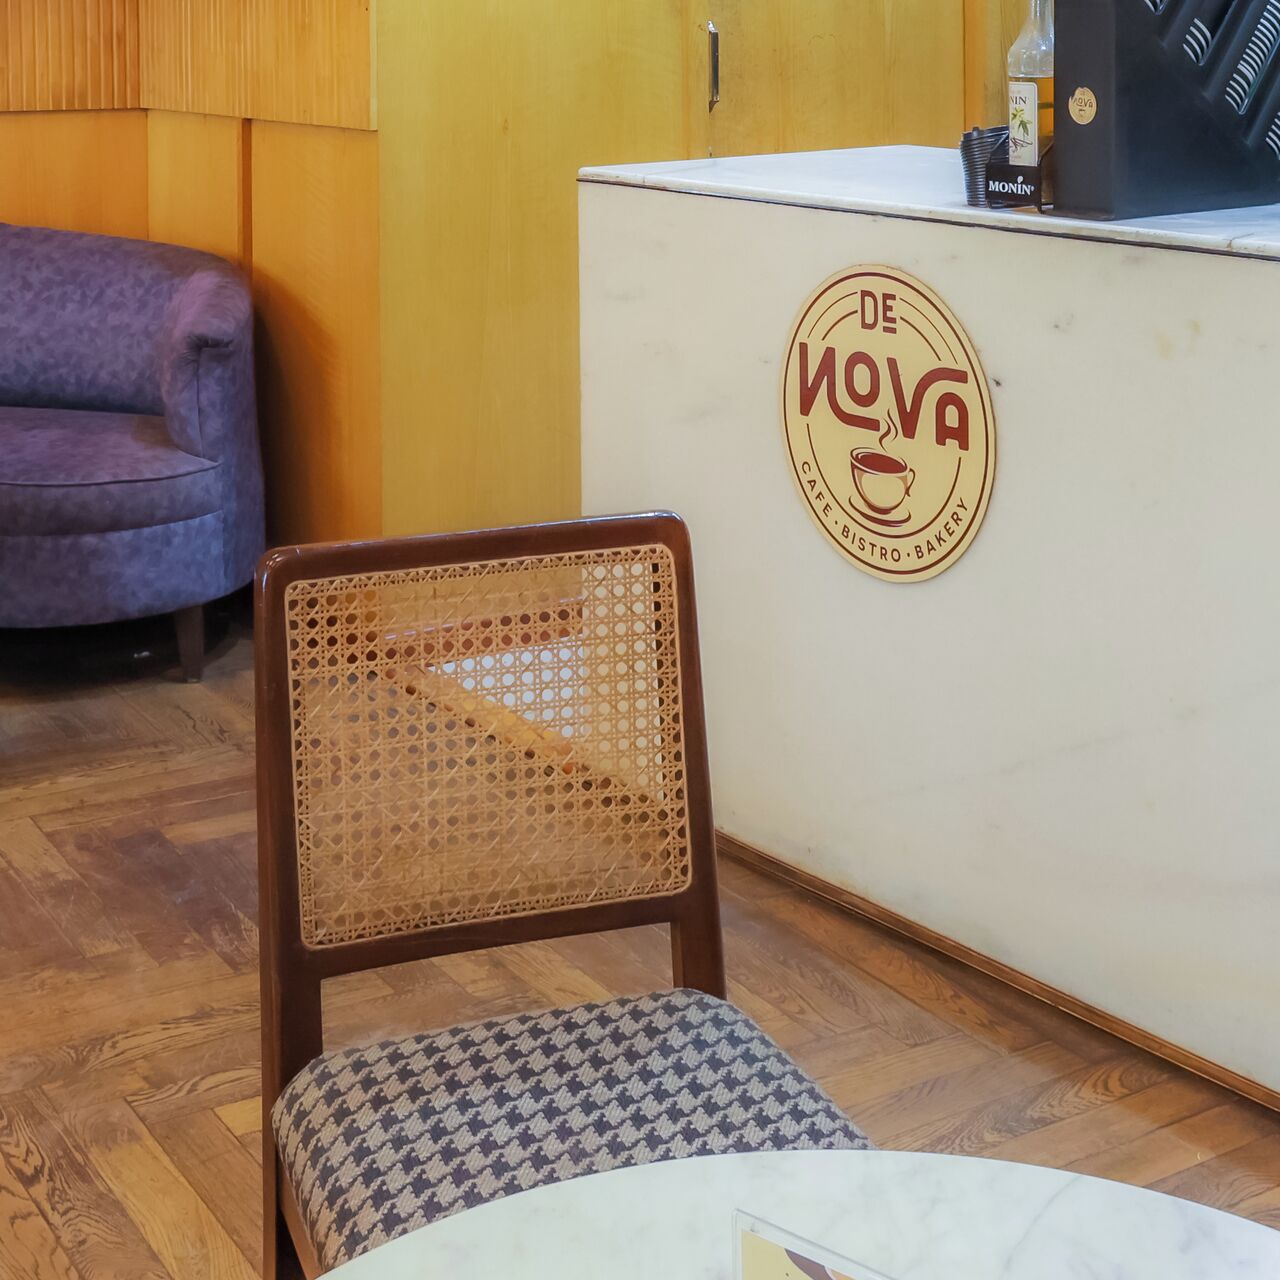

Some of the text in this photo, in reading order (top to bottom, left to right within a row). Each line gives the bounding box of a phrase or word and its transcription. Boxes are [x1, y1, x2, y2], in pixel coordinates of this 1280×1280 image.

[988, 176, 1030, 196] MONIN
[860, 289, 897, 334] DE
[799, 341, 970, 452] NOVA
[801, 461, 969, 563] CAFE BISTRO BAKERY
